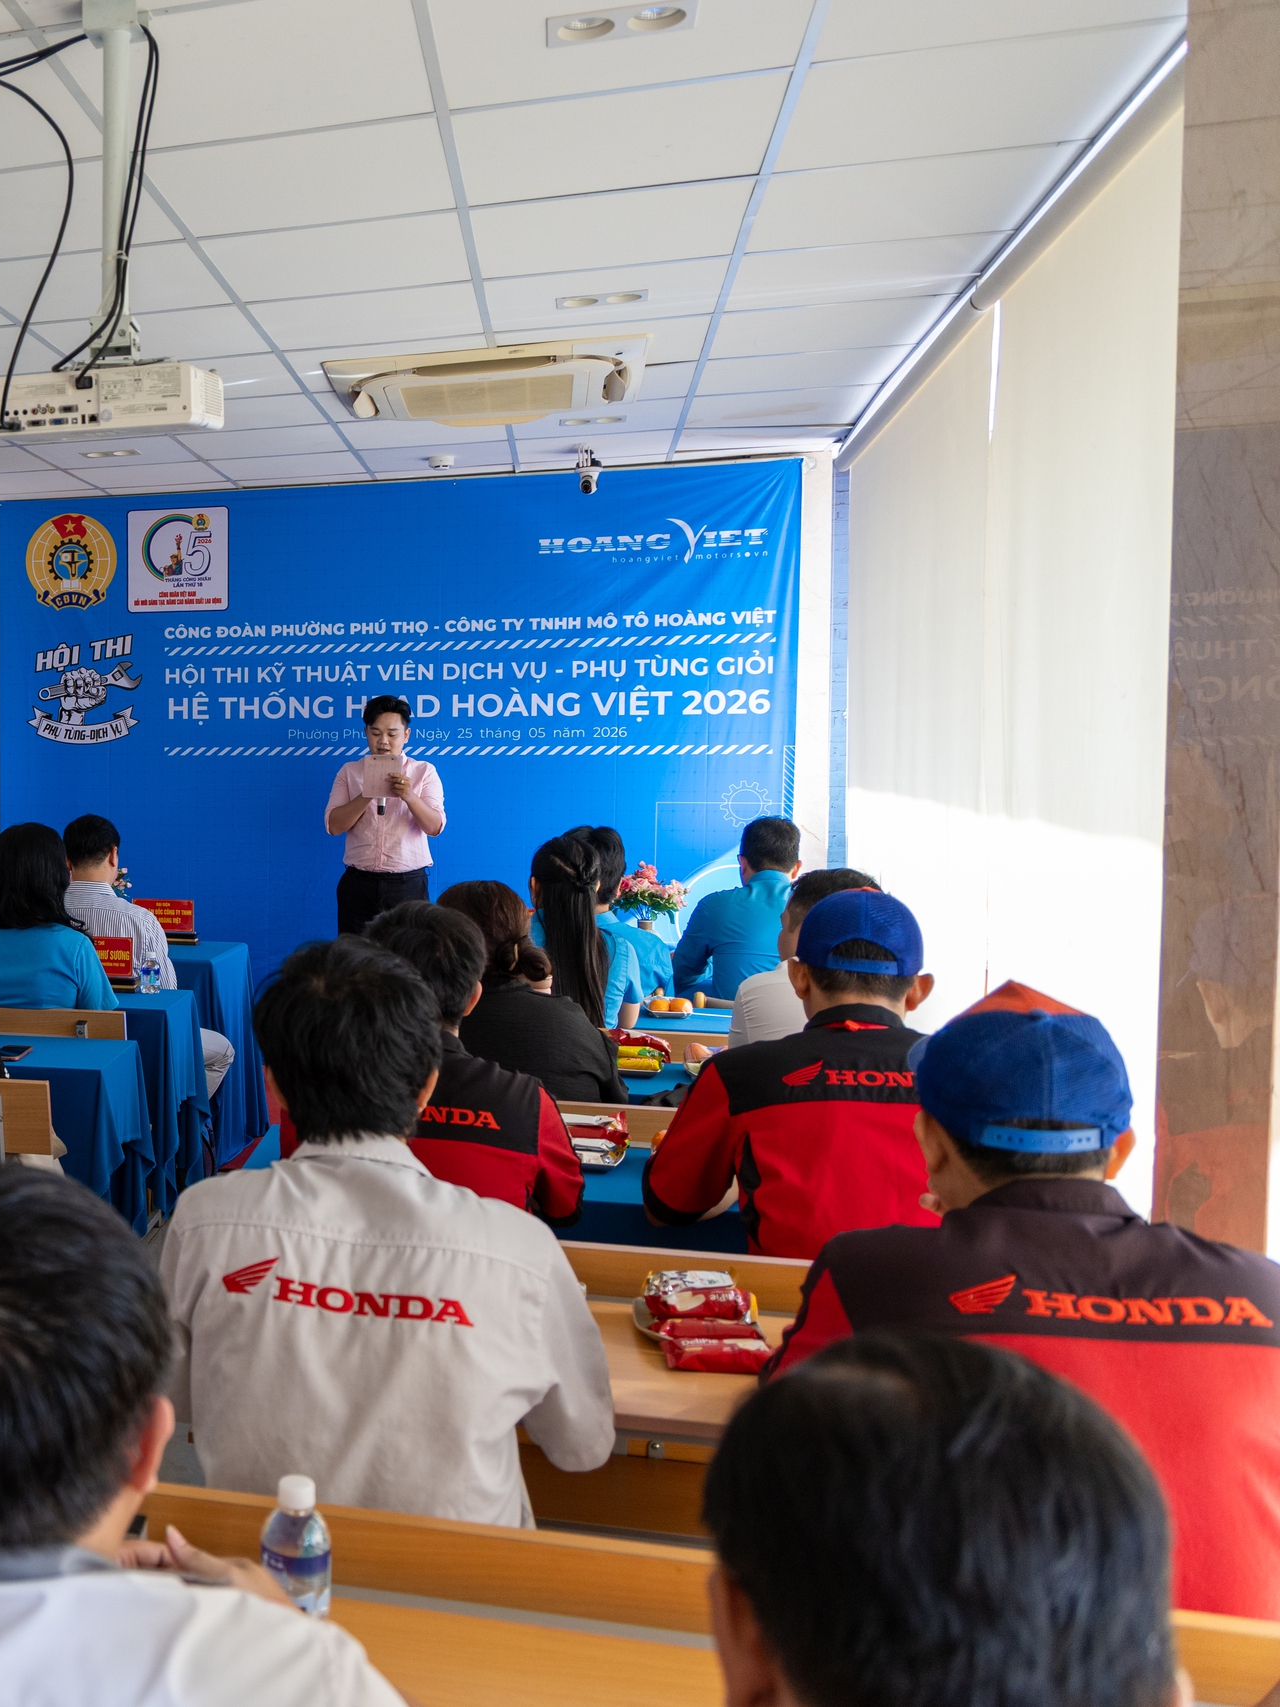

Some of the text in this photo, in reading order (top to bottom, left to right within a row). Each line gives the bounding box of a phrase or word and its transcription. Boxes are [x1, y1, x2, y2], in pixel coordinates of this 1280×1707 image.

[164, 623, 212, 640] CÔNG
[215, 622, 266, 638] ĐOÀN
[271, 620, 345, 637] PHƯỜNG
[349, 618, 387, 635] PHÚ
[390, 620, 429, 637] THỌ
[444, 616, 497, 633] CÔNG
[501, 618, 525, 631] TY
[528, 616, 582, 631] TNHH
[586, 611, 618, 629] MÔ
[622, 610, 649, 628] TÔ
[654, 609, 726, 627] HOÀNG
[730, 606, 777, 628] VIỆT
[35, 634, 133, 672] HỘI THI
[165, 663, 205, 689] HỘI
[211, 666, 249, 684] THI
[257, 661, 286, 683] KỸ
[291, 660, 372, 687] THUẬT
[377, 659, 434, 682] VIÊN
[442, 662, 504, 685] DỊCH
[511, 661, 547, 684] VỤ
[572, 659, 627, 683] PHỤ
[634, 653, 709, 677] TÙNG
[716, 649, 774, 676] GIỎI
[168, 684, 771, 726] HỆ THỐNG HD HOÀNG VIỆT 2026
[42, 723, 61, 739] PHỤ
[109, 722, 123, 737] VỤ
[288, 728, 339, 742] Phường
[415, 728, 451, 742] Ngày
[457, 727, 473, 739] 25
[479, 727, 521, 741] tháng
[528, 727, 546, 739] 05
[553, 727, 585, 739] năm
[592, 726, 628, 738] 2026
[824, 1069, 915, 1088] HON
[421, 1105, 501, 1131] NDA
[273, 1276, 474, 1327] HONDA
[1022, 1288, 1274, 1328] HONDA
